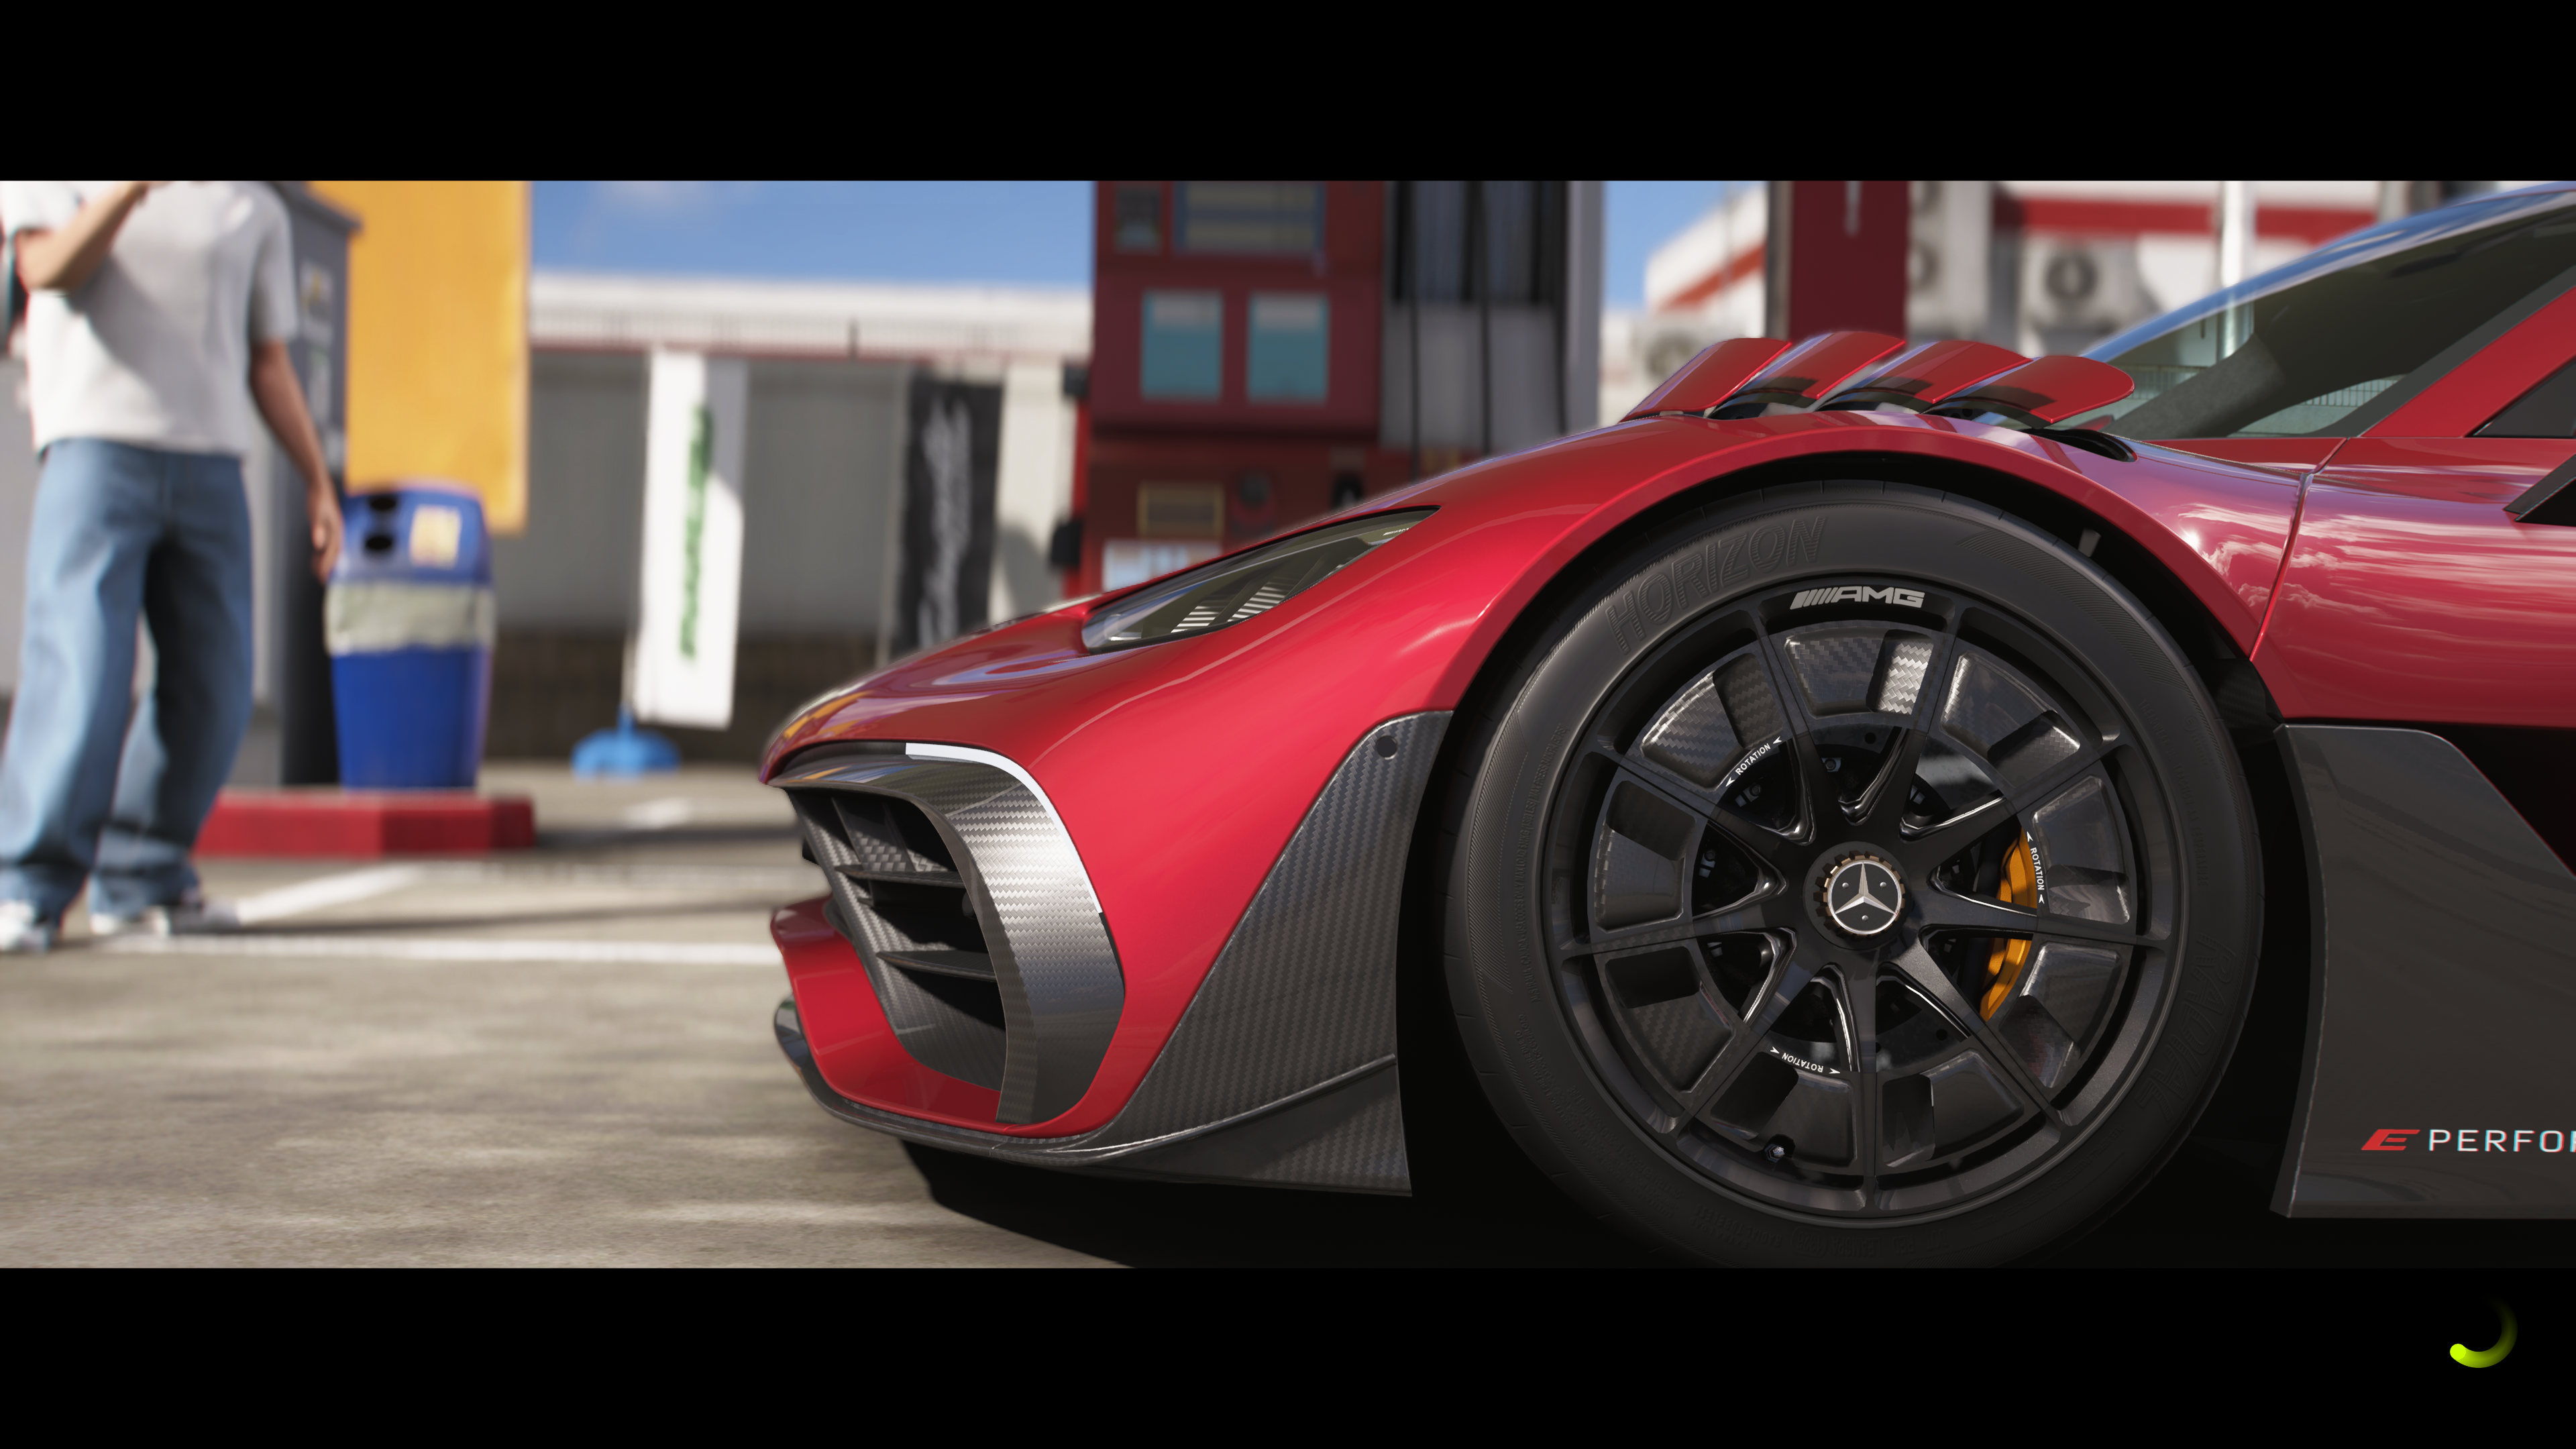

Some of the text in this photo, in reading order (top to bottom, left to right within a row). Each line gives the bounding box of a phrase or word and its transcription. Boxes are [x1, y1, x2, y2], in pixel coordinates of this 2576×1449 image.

[1605, 516, 1827, 655] HORIZON
[1831, 586, 1925, 608] AMG
[1735, 743, 1771, 775] ROTATION
[2171, 762, 2195, 806] TRACTION
[2190, 824, 2208, 886] TEMPERATURE
[2030, 847, 2045, 890] ROTATION
[2135, 932, 2237, 1122] RADIAL
[1781, 1052, 1824, 1073] ROTATION
[2361, 1129, 2421, 1150] E
[1686, 1215, 1750, 1250] EXTRA LOAD
[1692, 1201, 1783, 1248] RADIAL TUBELESS
[1923, 1228, 1949, 1252] DOT
[1830, 1236, 1882, 1257] LEAMSPA
